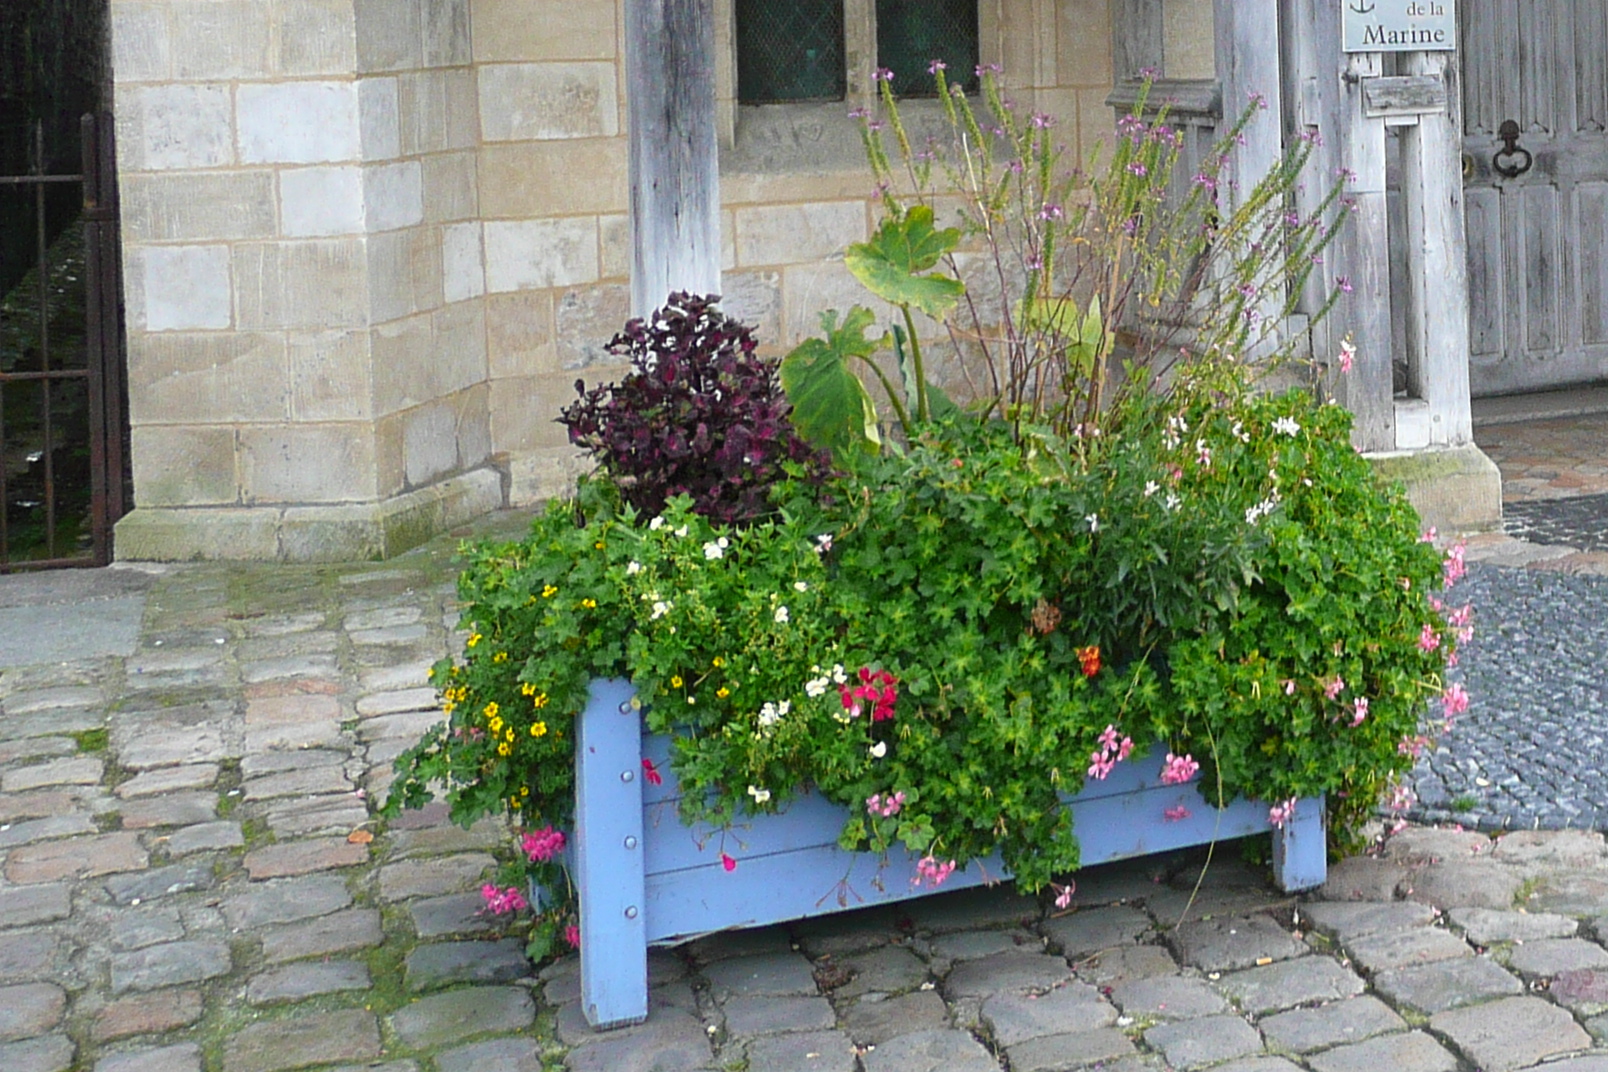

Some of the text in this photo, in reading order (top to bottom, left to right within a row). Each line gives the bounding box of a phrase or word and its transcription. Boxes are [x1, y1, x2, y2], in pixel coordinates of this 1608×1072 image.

[1406, 1, 1444, 16] de la
[1362, 23, 1445, 45] Marine
